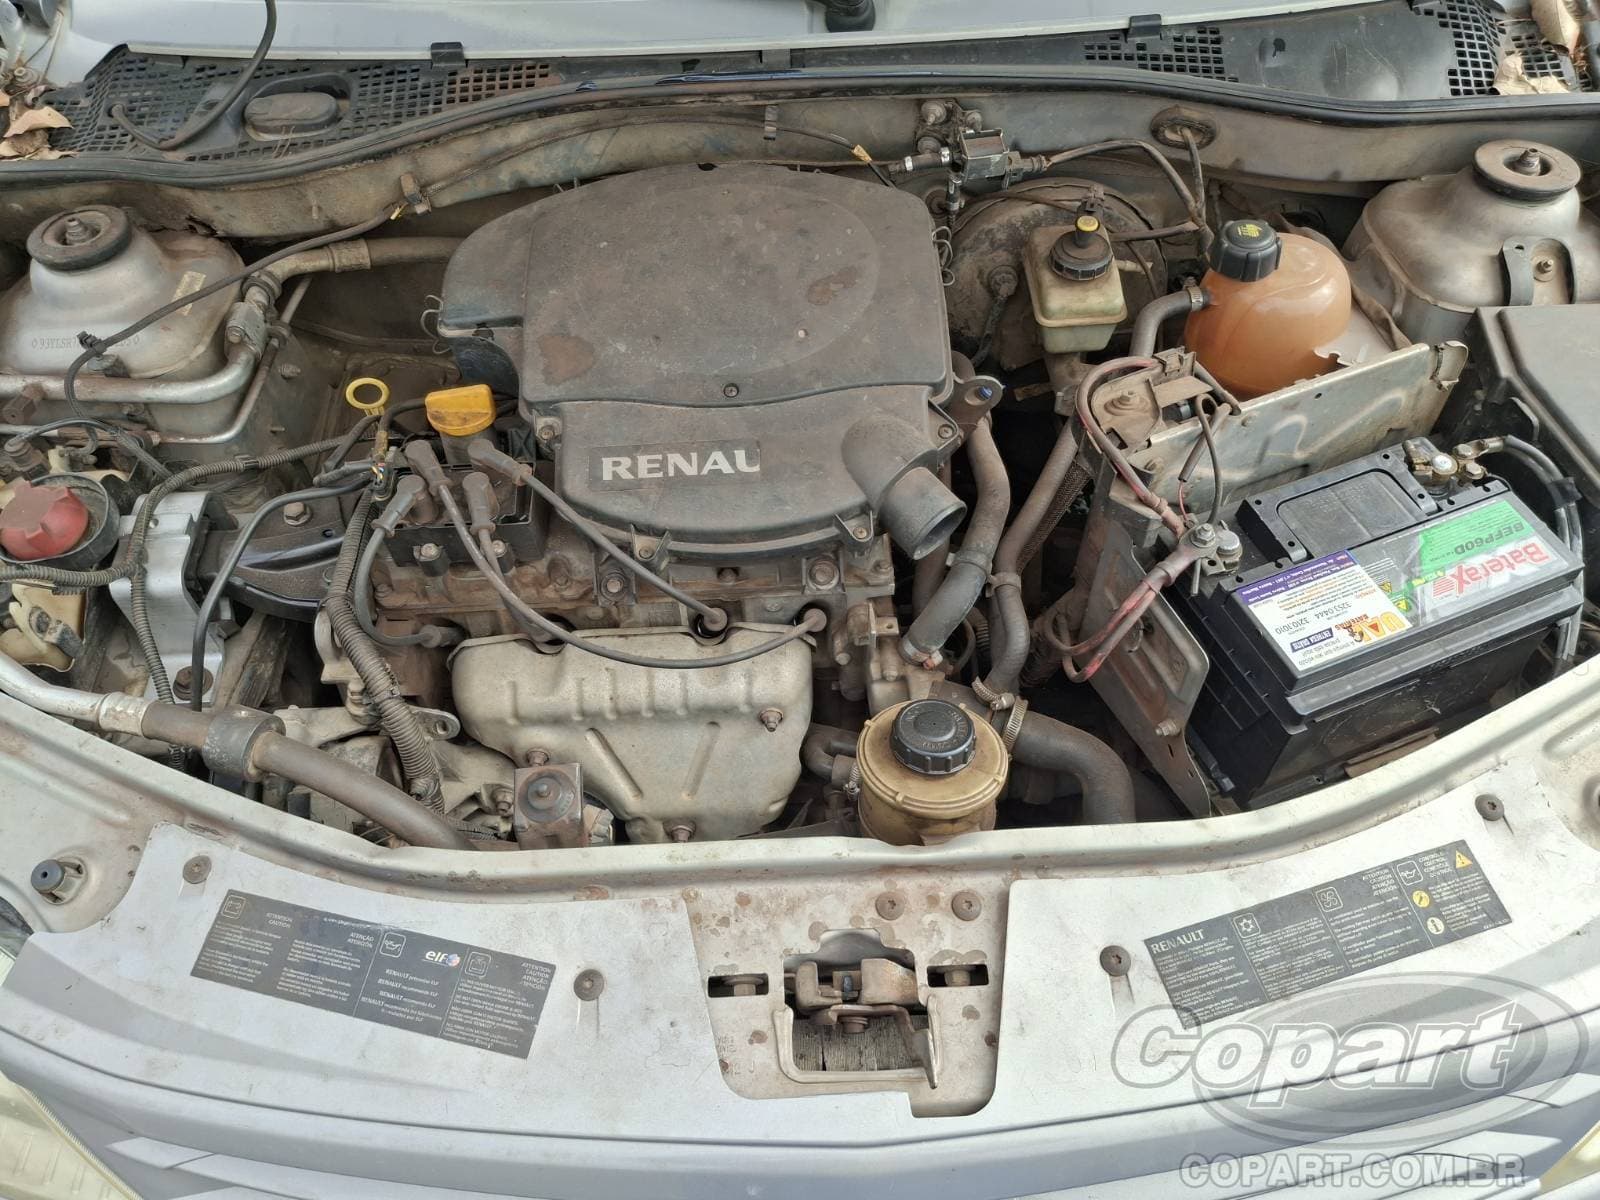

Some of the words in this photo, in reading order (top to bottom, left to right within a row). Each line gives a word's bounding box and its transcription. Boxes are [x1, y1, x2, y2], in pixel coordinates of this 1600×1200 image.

[1455, 521, 1525, 555] BEFP60D
[1334, 614, 1368, 630] BATERIAS
[1151, 929, 1205, 952] RENAULT
[425, 949, 447, 962] elf
